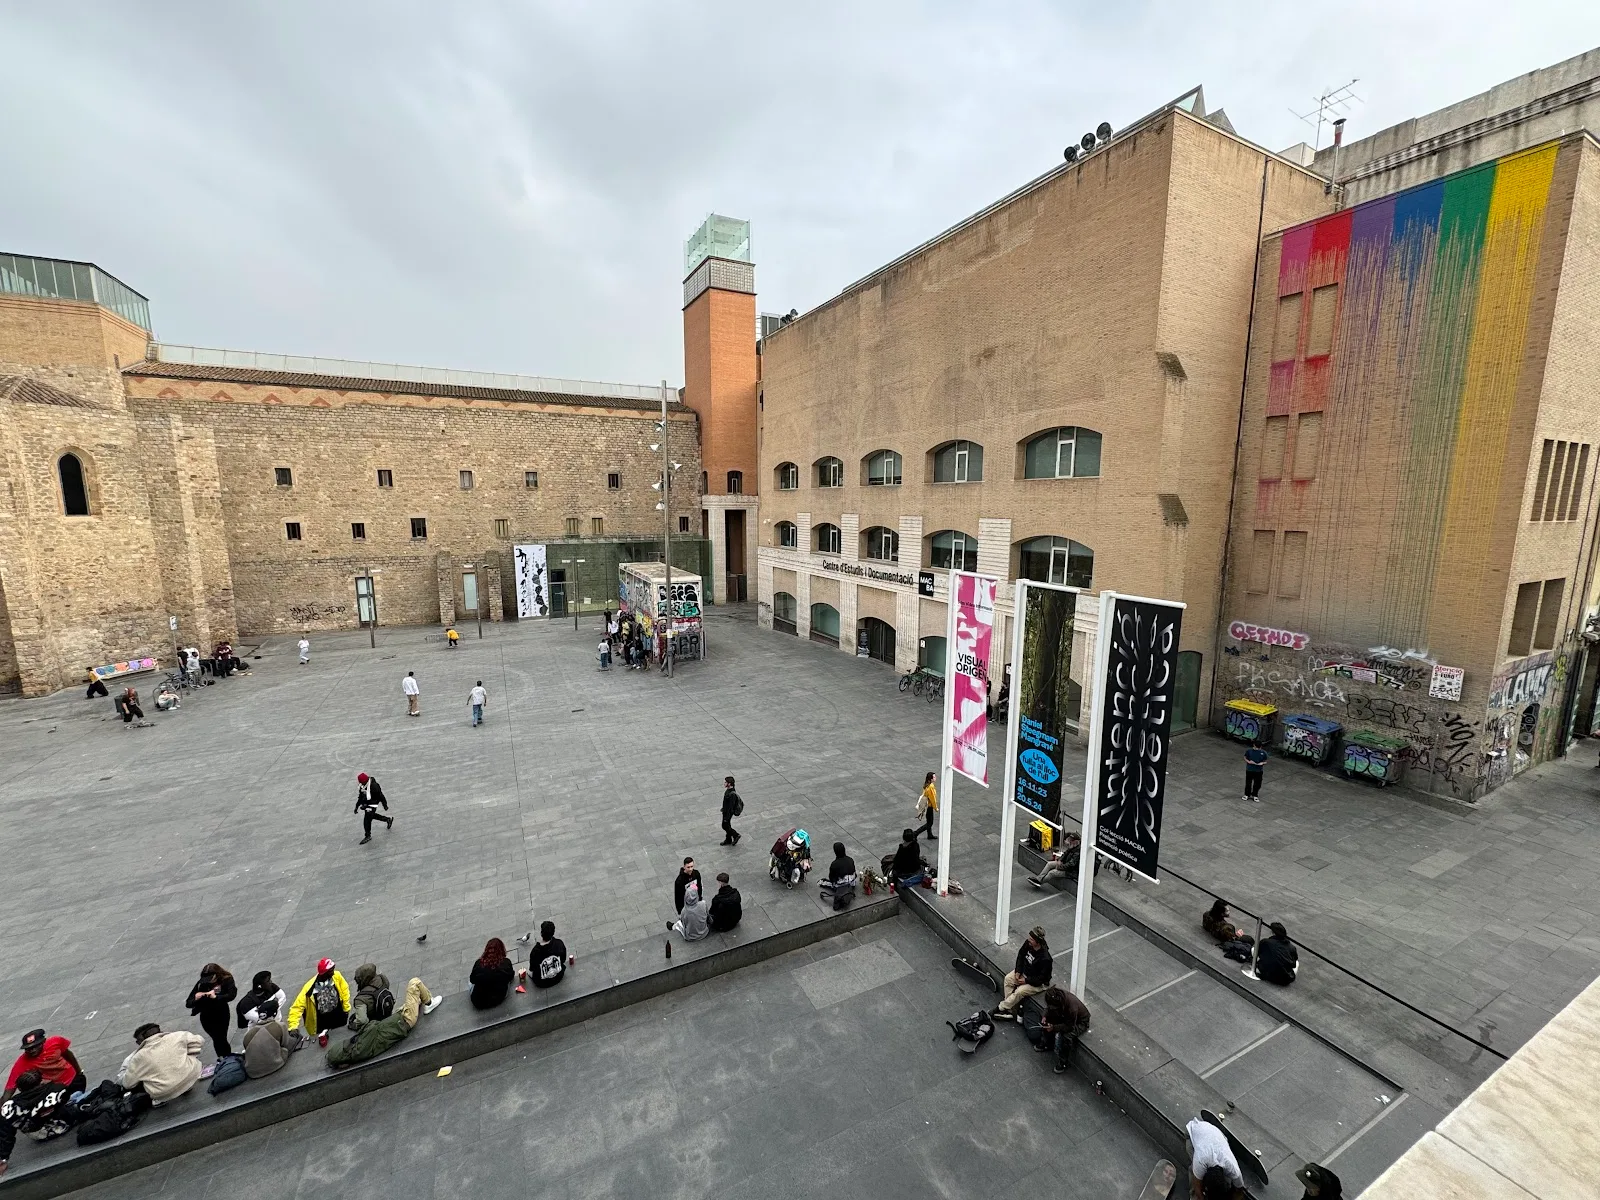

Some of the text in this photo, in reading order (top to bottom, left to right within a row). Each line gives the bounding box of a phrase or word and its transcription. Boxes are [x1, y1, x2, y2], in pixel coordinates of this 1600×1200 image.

[822, 559, 839, 571] Centre
[840, 562, 864, 577] d'Estudis
[868, 567, 914, 586] Documentació
[920, 576, 933, 585] MAC
[925, 584, 934, 592] BA
[957, 652, 987, 671] VISUAL
[1021, 714, 1043, 730] Daniel
[1020, 730, 1054, 752] Mangrané
[1021, 722, 1059, 746] Steegmann
[1032, 752, 1046, 765] Una
[1028, 766, 1037, 776] de
[1017, 785, 1024, 794] al
[1016, 792, 1043, 812] 20.5.24
